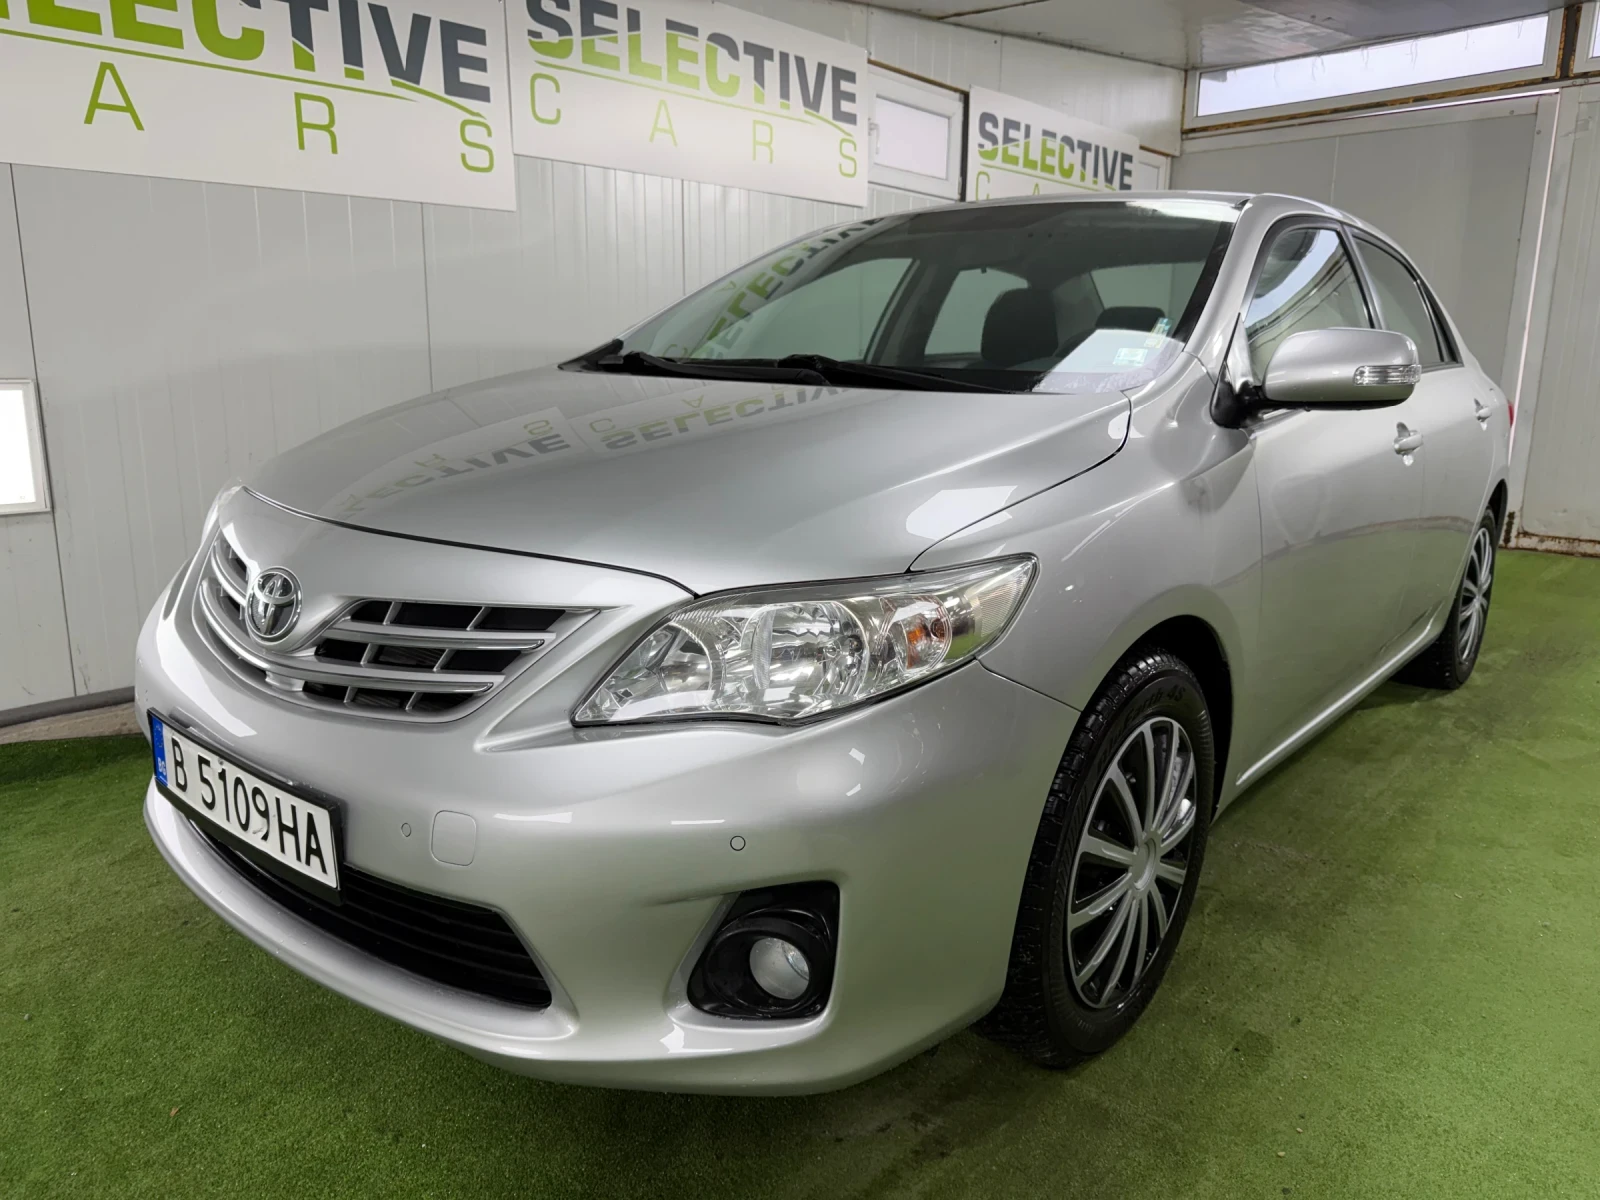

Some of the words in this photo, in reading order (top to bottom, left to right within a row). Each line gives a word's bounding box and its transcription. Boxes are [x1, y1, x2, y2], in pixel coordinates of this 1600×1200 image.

[526, 0, 857, 126] SELECTIVE
[977, 111, 1133, 191] SELECTIVE
[157, 757, 168, 777] BG
